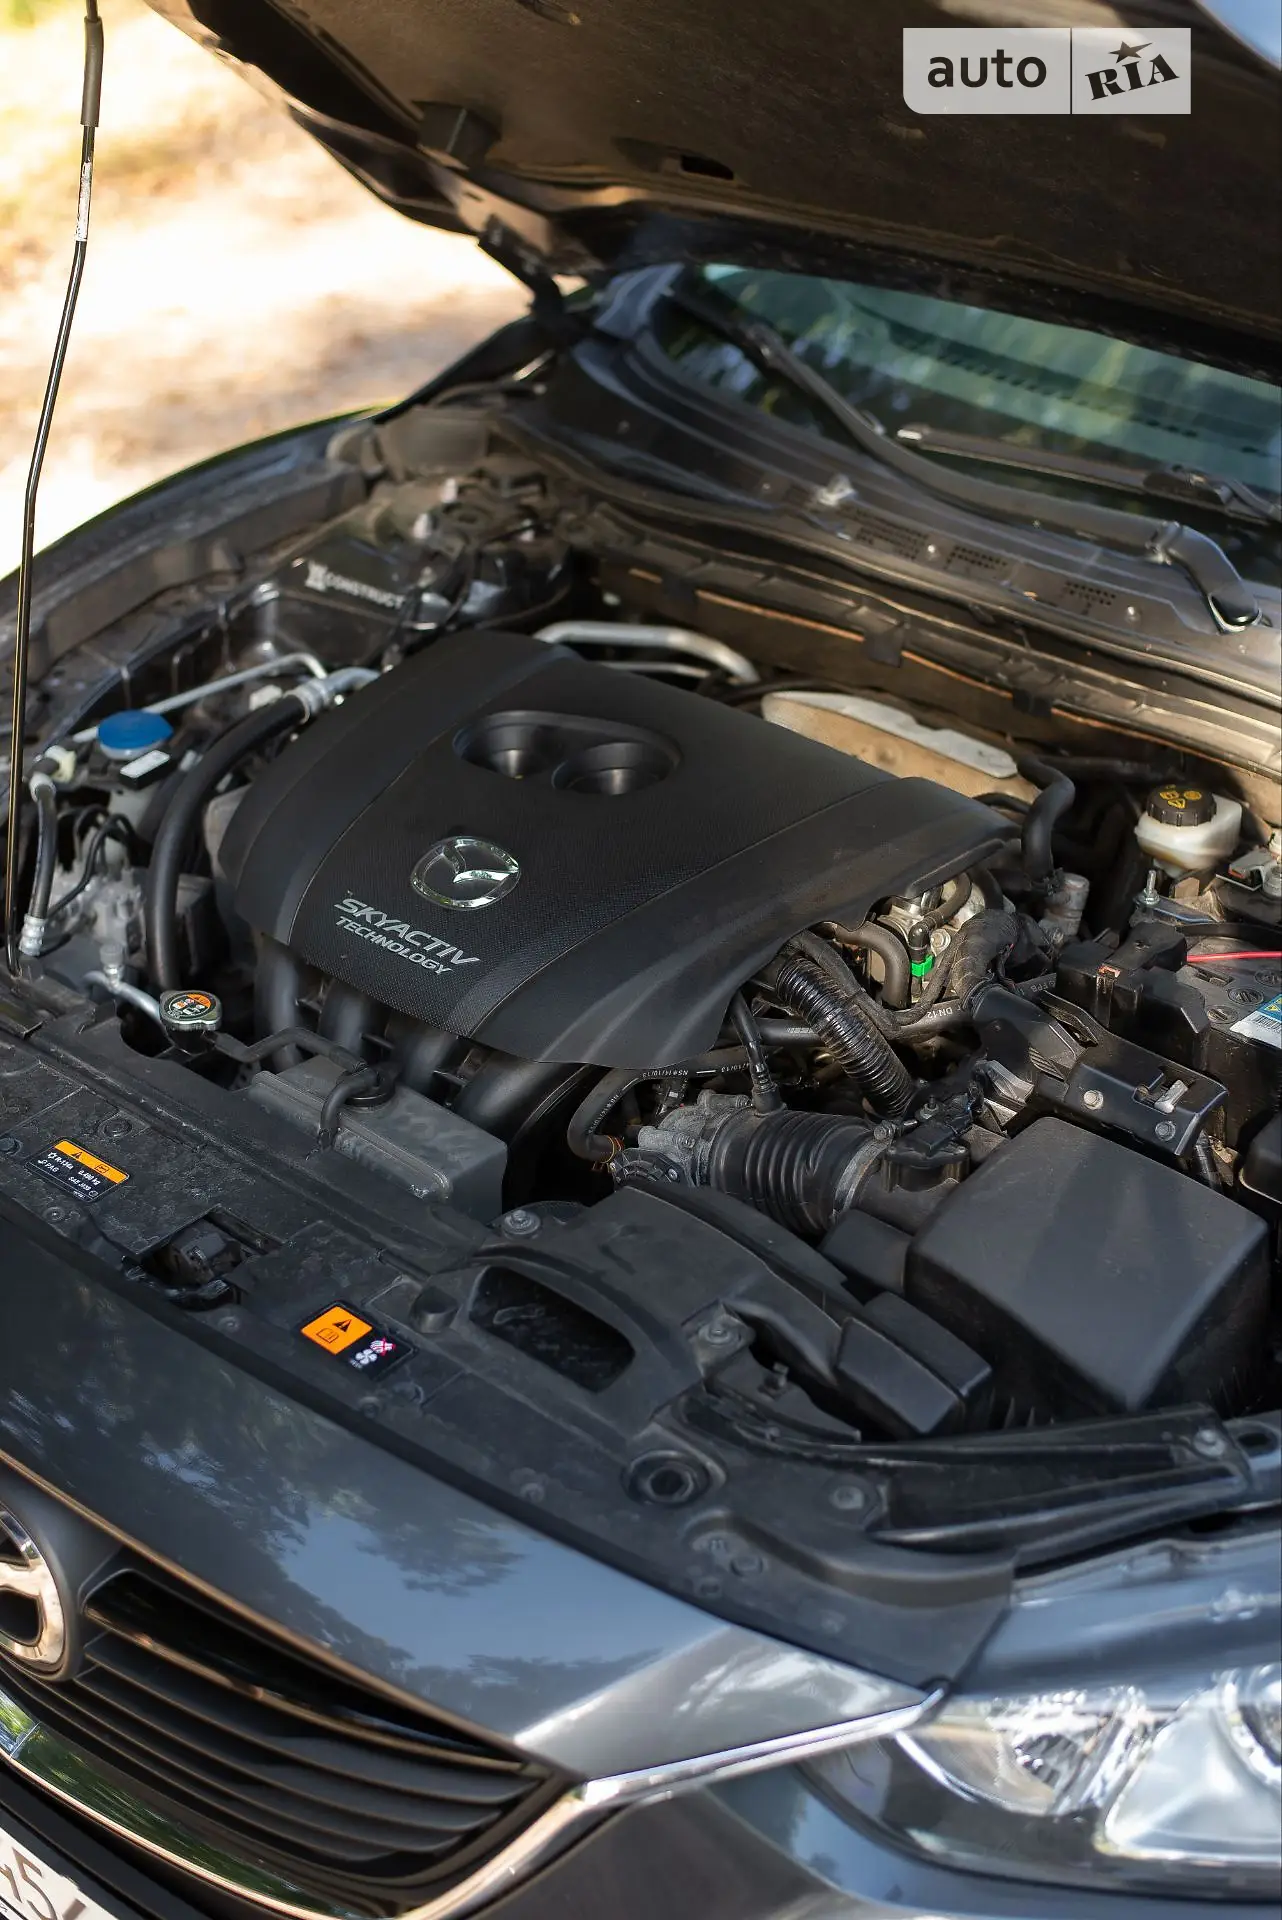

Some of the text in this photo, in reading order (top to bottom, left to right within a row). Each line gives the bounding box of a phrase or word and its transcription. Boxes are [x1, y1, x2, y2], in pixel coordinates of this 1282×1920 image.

[334, 898, 481, 965] SKYACTIV
[335, 916, 453, 976] TECHNOLOGY
[45, 1162, 60, 1173] PAG
